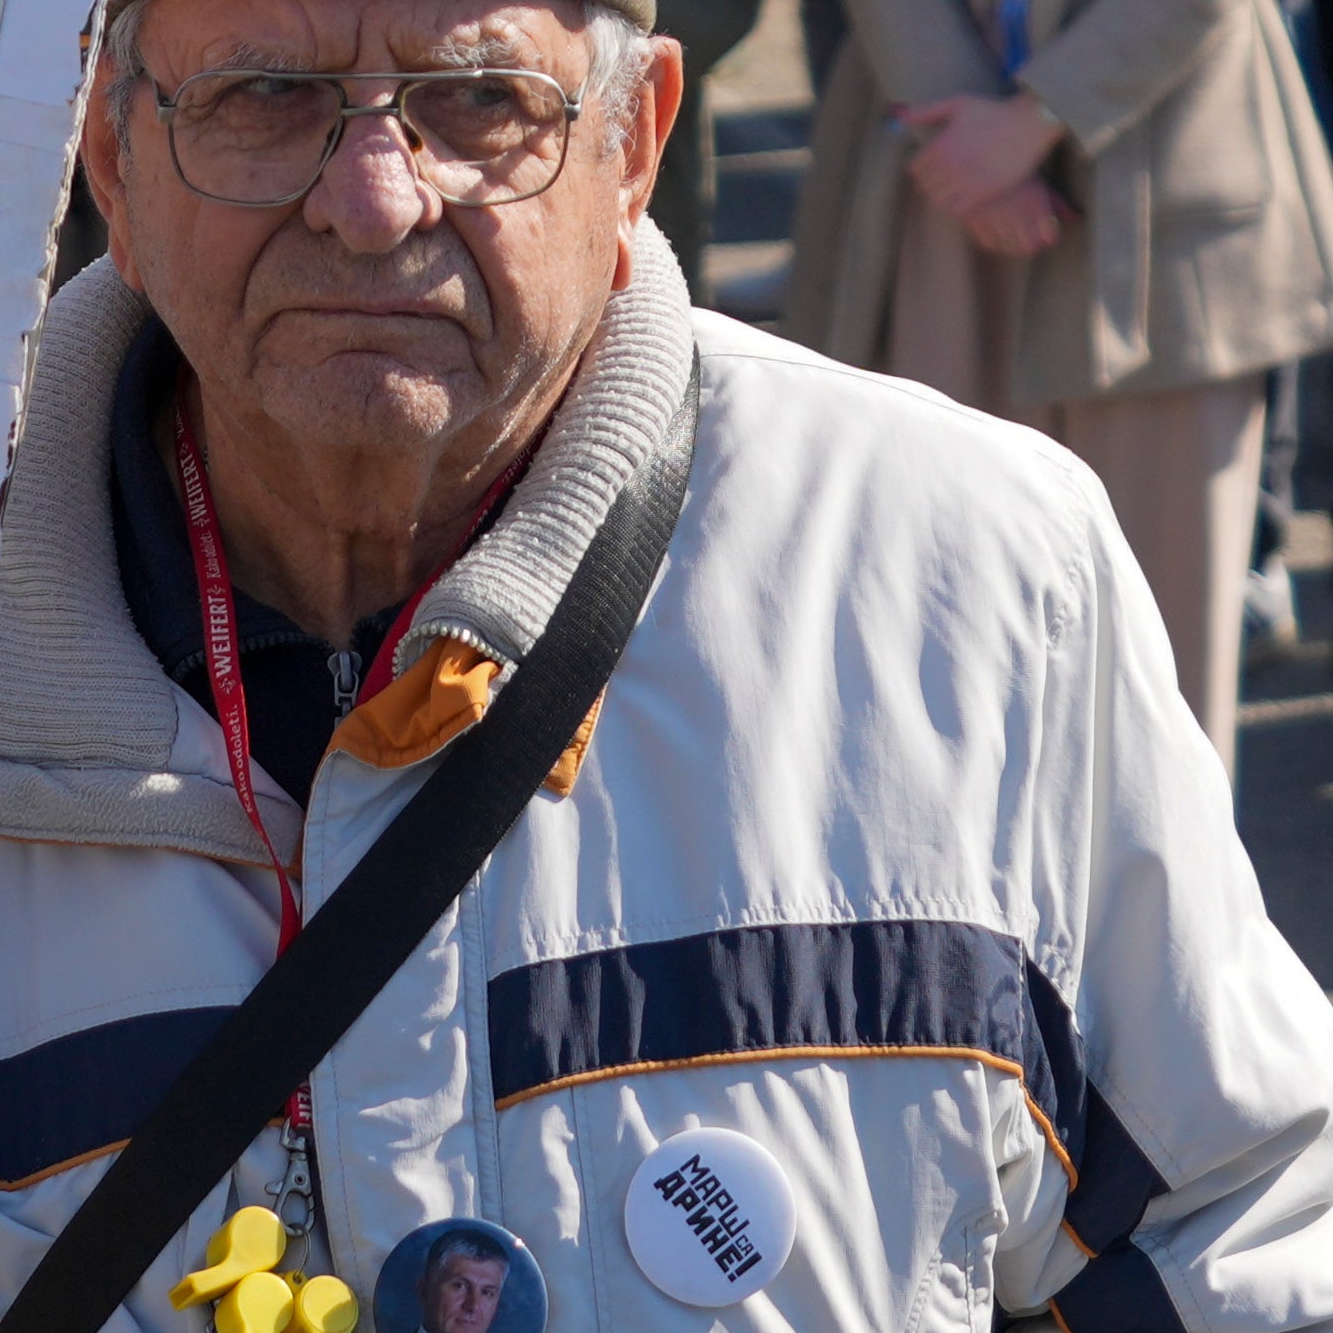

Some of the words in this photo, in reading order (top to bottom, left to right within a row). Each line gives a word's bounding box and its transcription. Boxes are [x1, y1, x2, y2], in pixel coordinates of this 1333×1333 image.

[180, 453, 207, 520] WEIFERT
[208, 595, 233, 678] WEIFERT
[653, 1169, 763, 1282] ДРИНЕ!
[680, 1154, 750, 1238] МАРШ
[735, 1234, 754, 1256] СА
